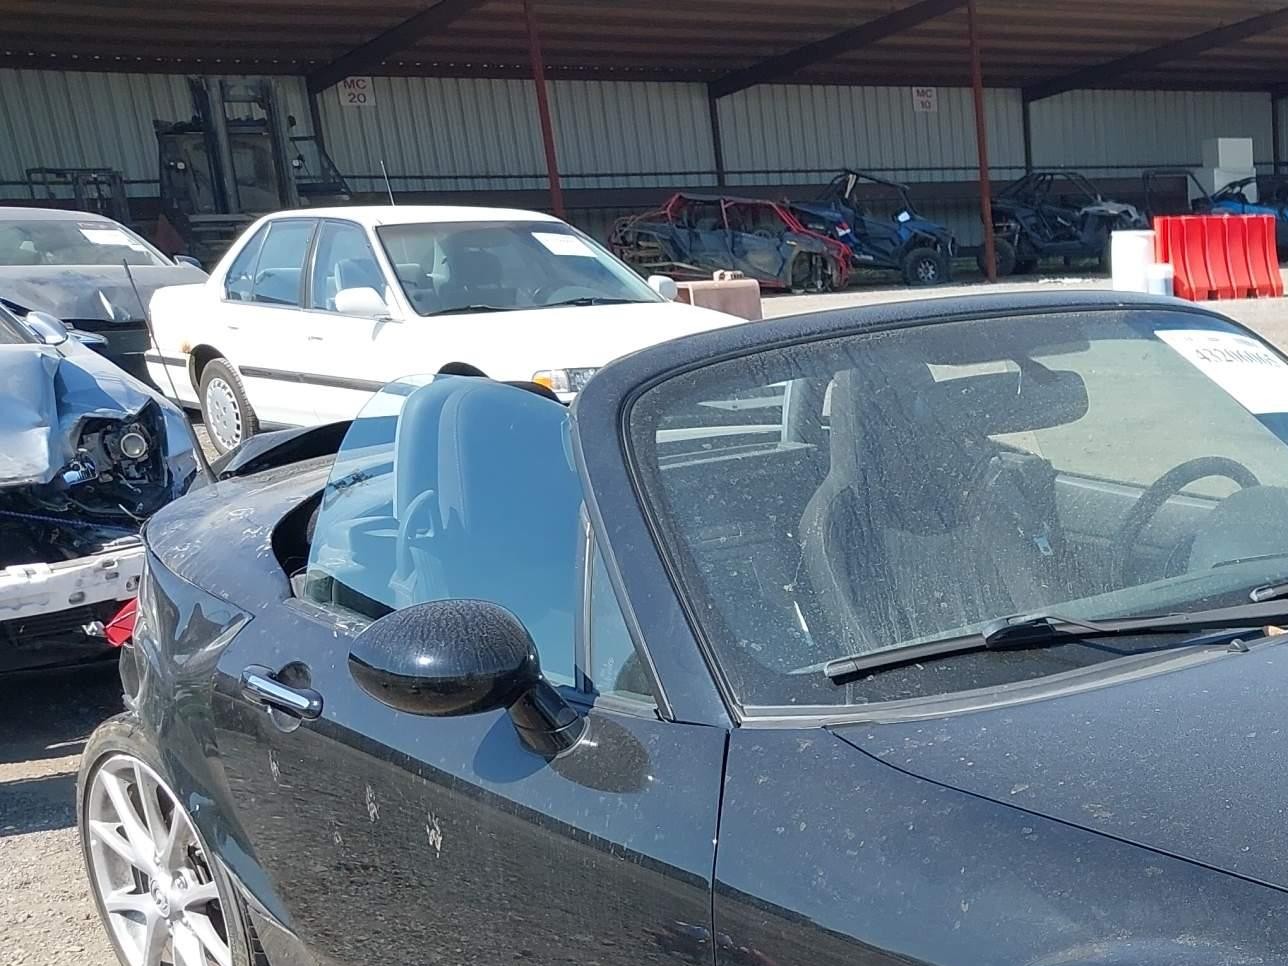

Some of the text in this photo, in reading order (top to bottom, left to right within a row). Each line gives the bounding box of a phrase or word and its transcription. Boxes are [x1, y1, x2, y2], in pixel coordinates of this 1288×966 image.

[344, 79, 367, 89] MC
[348, 93, 367, 103] 20
[916, 89, 932, 98] MC
